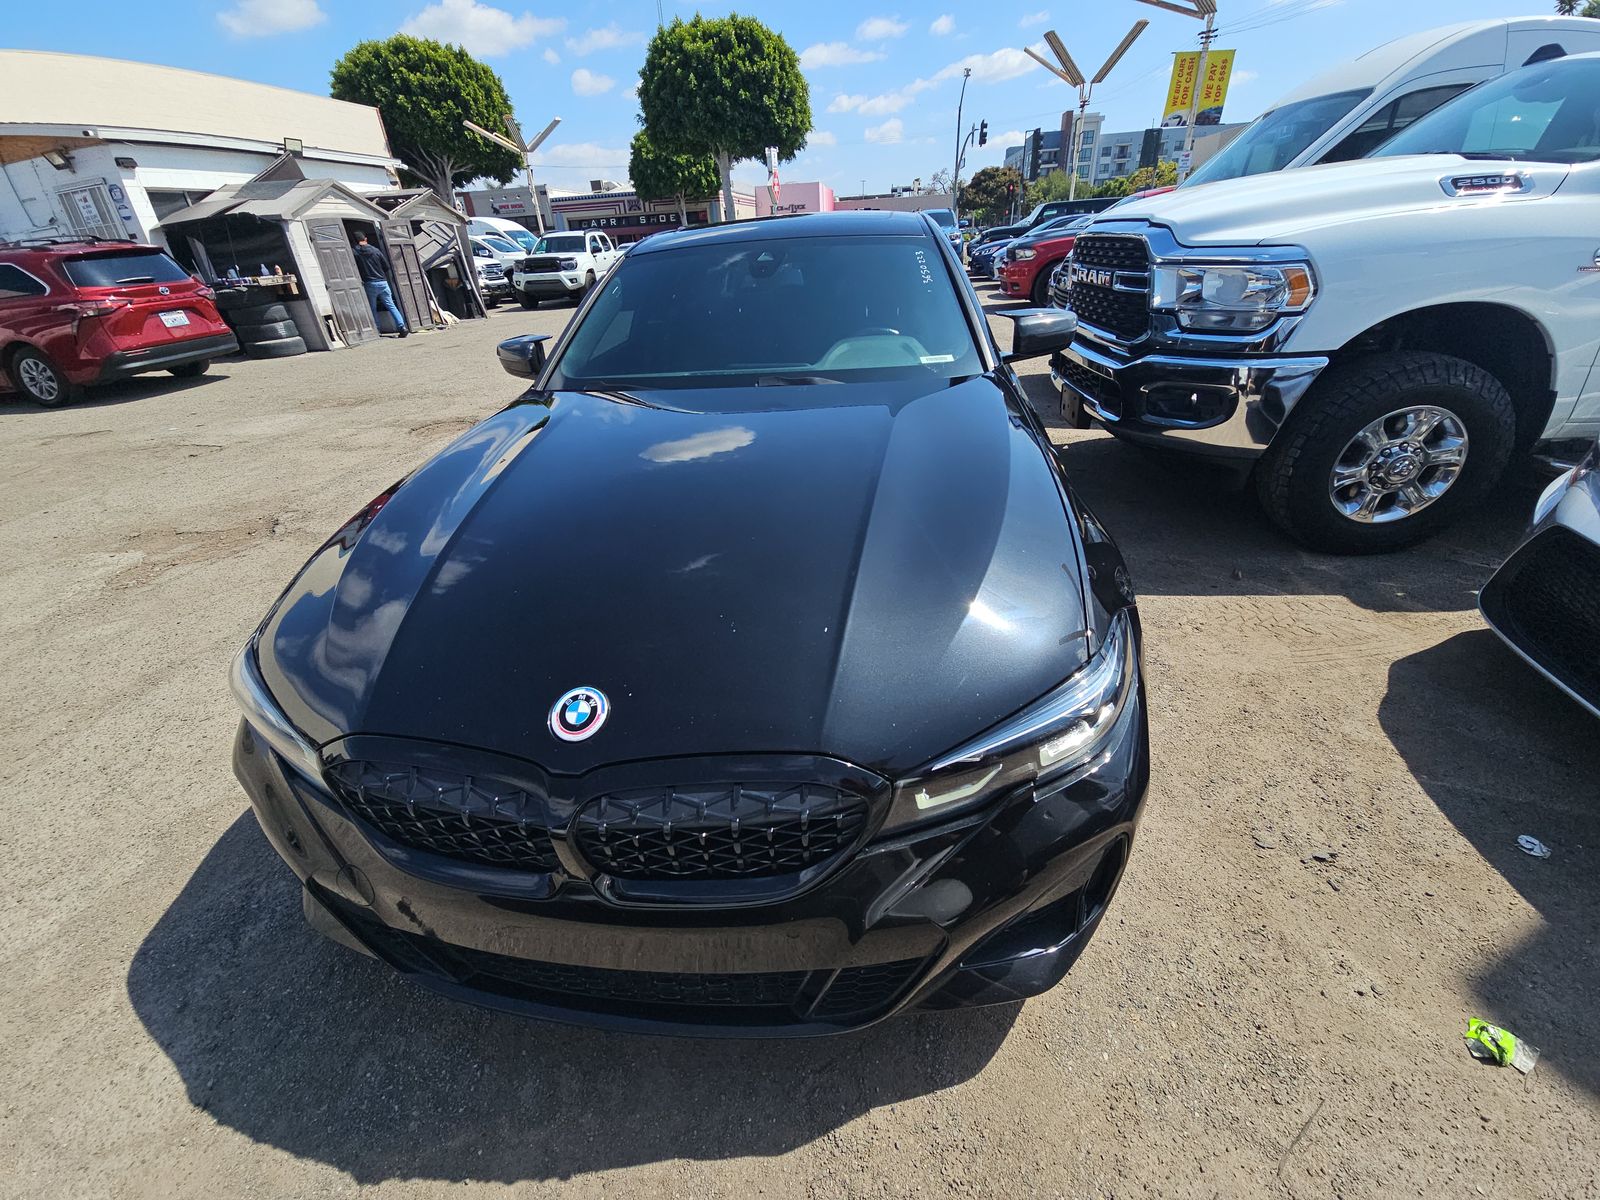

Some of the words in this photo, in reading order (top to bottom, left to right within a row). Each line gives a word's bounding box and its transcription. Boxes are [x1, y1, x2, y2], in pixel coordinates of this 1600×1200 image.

[1208, 63, 1218, 81] PAY
[1171, 95, 1179, 107] WE
[1178, 57, 1187, 78] CARS
[1180, 86, 1190, 106] FOR
[1185, 57, 1196, 84] CASH
[1204, 83, 1214, 99] WE
[1213, 85, 1222, 103] TOP
[1457, 175, 1515, 187] 2500
[639, 214, 677, 224] SHOE
[1078, 268, 1112, 286] RAM
[565, 694, 597, 707] BMW
